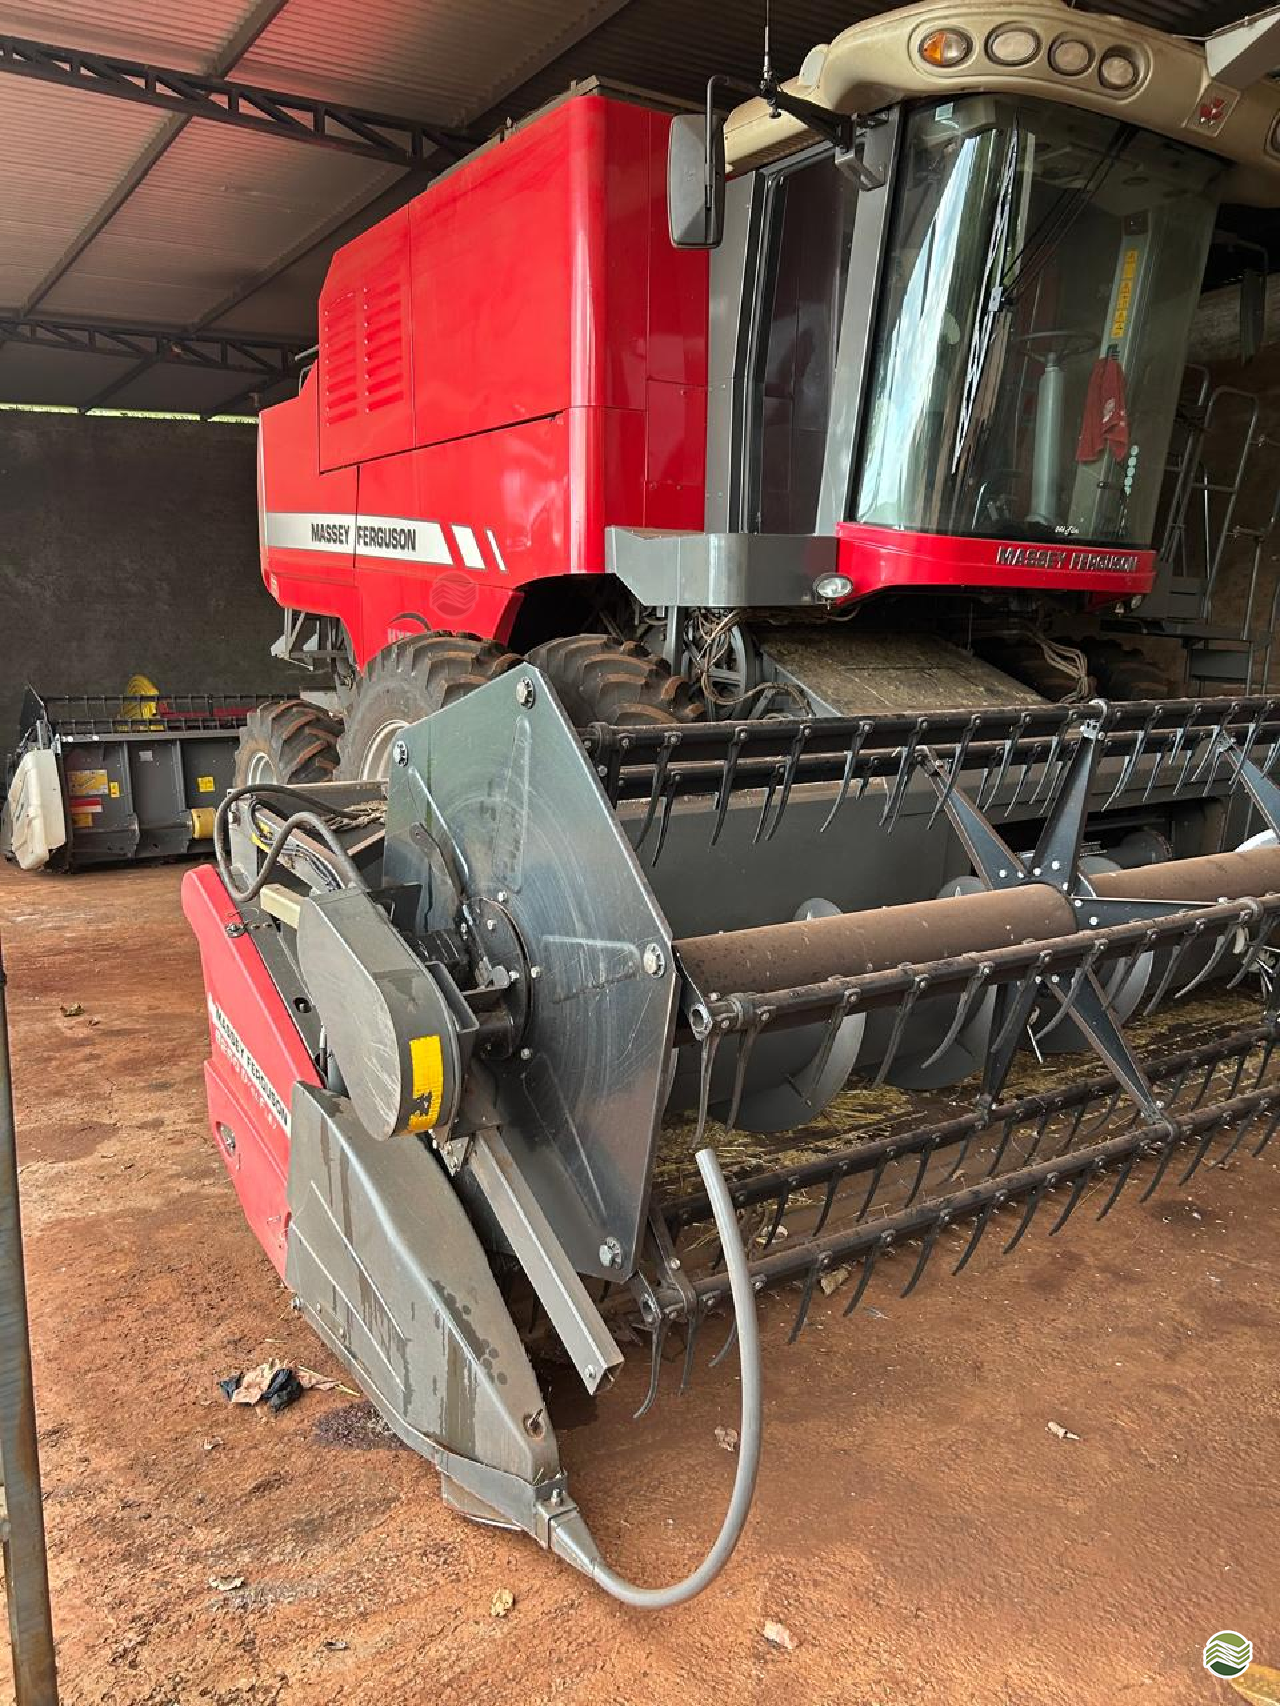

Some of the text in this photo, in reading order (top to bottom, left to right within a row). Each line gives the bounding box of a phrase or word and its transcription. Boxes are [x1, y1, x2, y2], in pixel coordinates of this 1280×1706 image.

[311, 523, 416, 552] MASSEY FERGUSON
[996, 546, 1138, 573] MASSEY FERGUSON
[214, 1006, 245, 1058] MASSEY
[246, 1054, 289, 1127] FERGUSON
